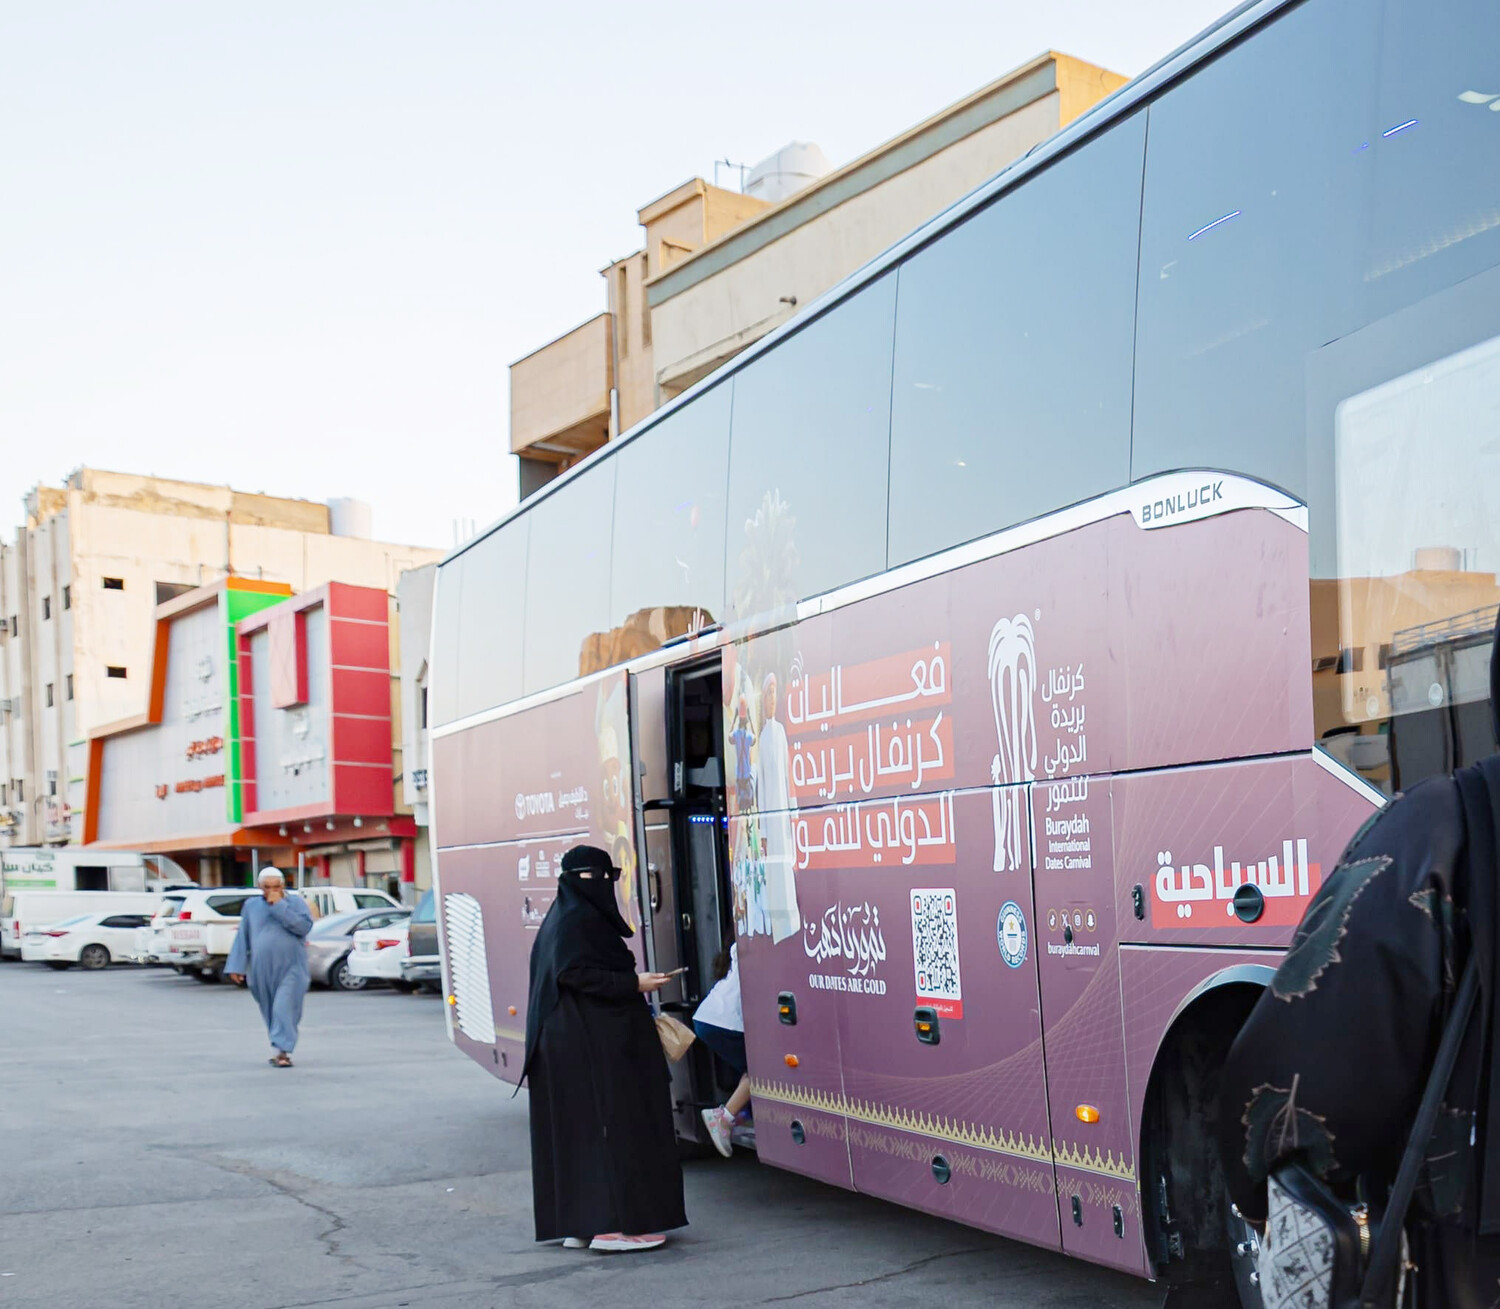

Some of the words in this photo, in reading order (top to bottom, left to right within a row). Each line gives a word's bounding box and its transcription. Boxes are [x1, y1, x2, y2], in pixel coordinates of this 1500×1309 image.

[1142, 480, 1224, 523] BONLUCK
[788, 640, 946, 732] فعاليات
[1041, 663, 1086, 702] كرنفال
[1050, 703, 1086, 733] بريدة
[791, 741, 854, 800] بريدة
[859, 711, 944, 793] كرنفال
[1044, 734, 1087, 780] الدولي
[525, 792, 555, 816] TOYOTA
[1046, 775, 1089, 812] للتمور
[865, 789, 956, 865] الدولي
[1045, 813, 1090, 841] Buraydah
[1048, 838, 1091, 853] International
[1045, 856, 1064, 870] Dates
[1064, 853, 1092, 870] Carnival
[1155, 838, 1309, 919] السياحية
[809, 973, 825, 989] OUR
[825, 974, 847, 992] DATES
[847, 977, 864, 993] ARE
[863, 978, 887, 995] GOLD
